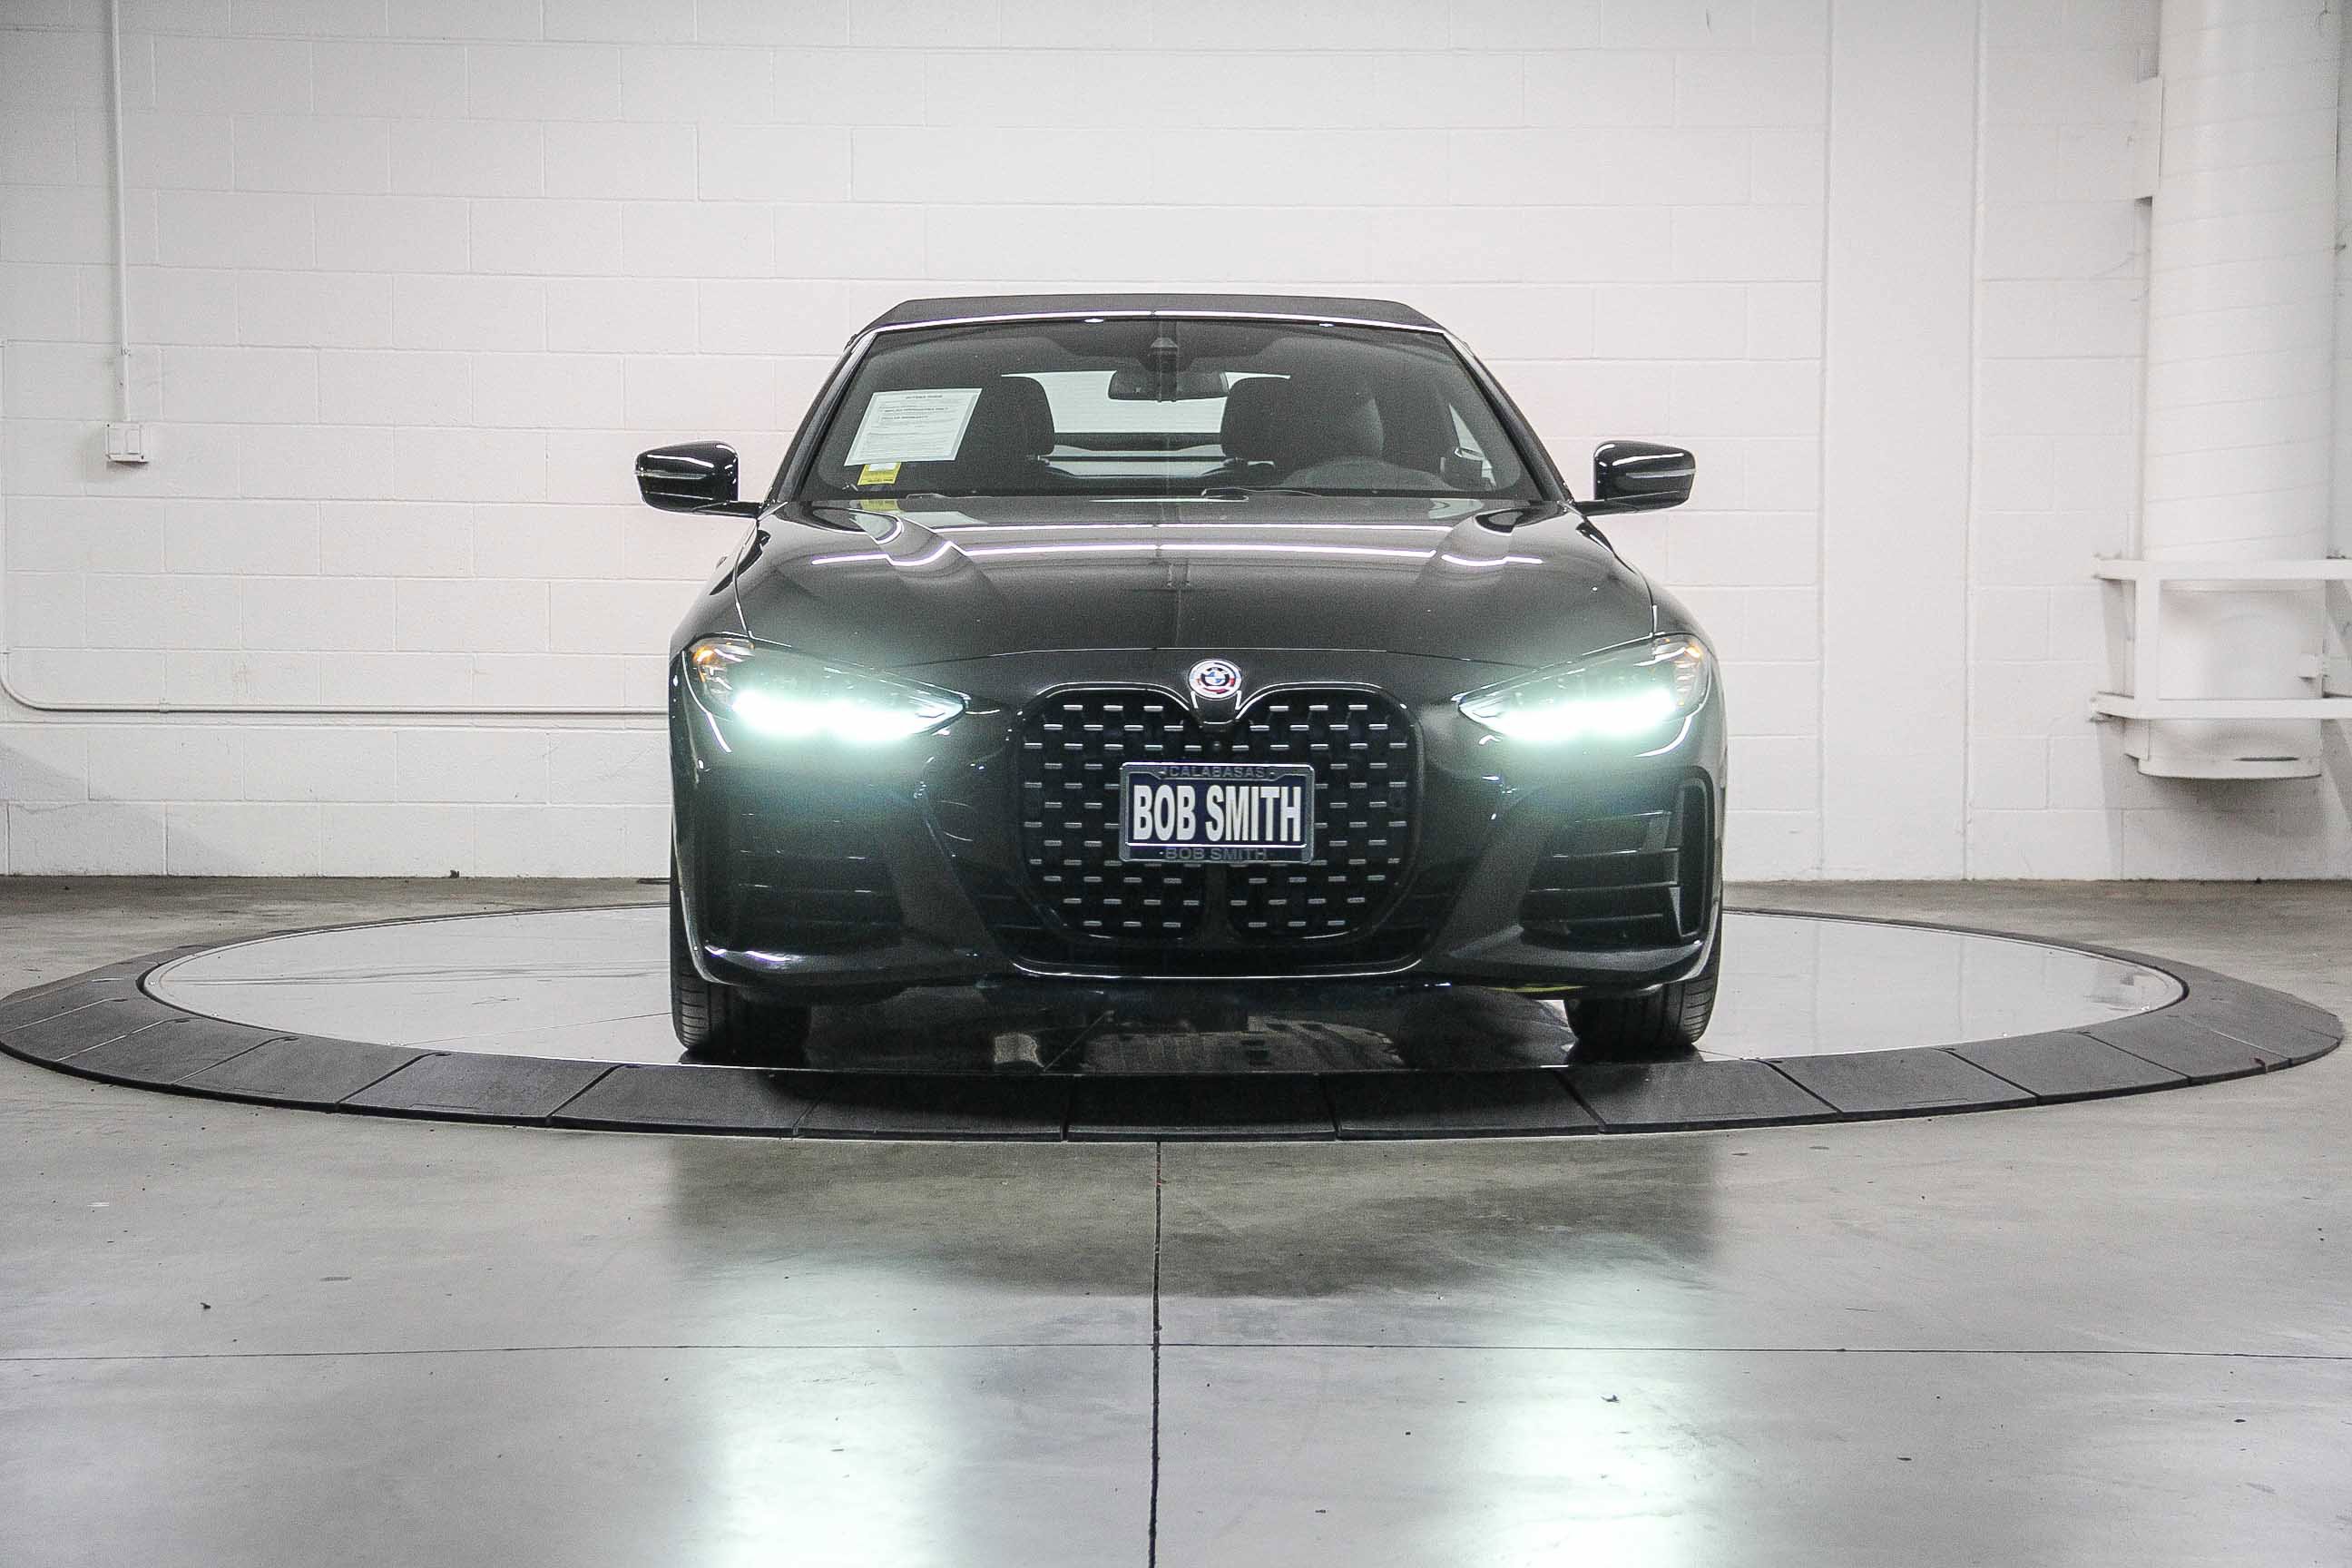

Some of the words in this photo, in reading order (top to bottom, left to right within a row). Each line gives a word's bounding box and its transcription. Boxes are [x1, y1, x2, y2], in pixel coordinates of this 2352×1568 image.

[1170, 766, 1265, 779] CALABASAS
[1132, 784, 1196, 841] BOB
[1205, 784, 1302, 842] SMITH
[1164, 848, 1205, 860] BOB
[1210, 848, 1268, 861] SMITH
